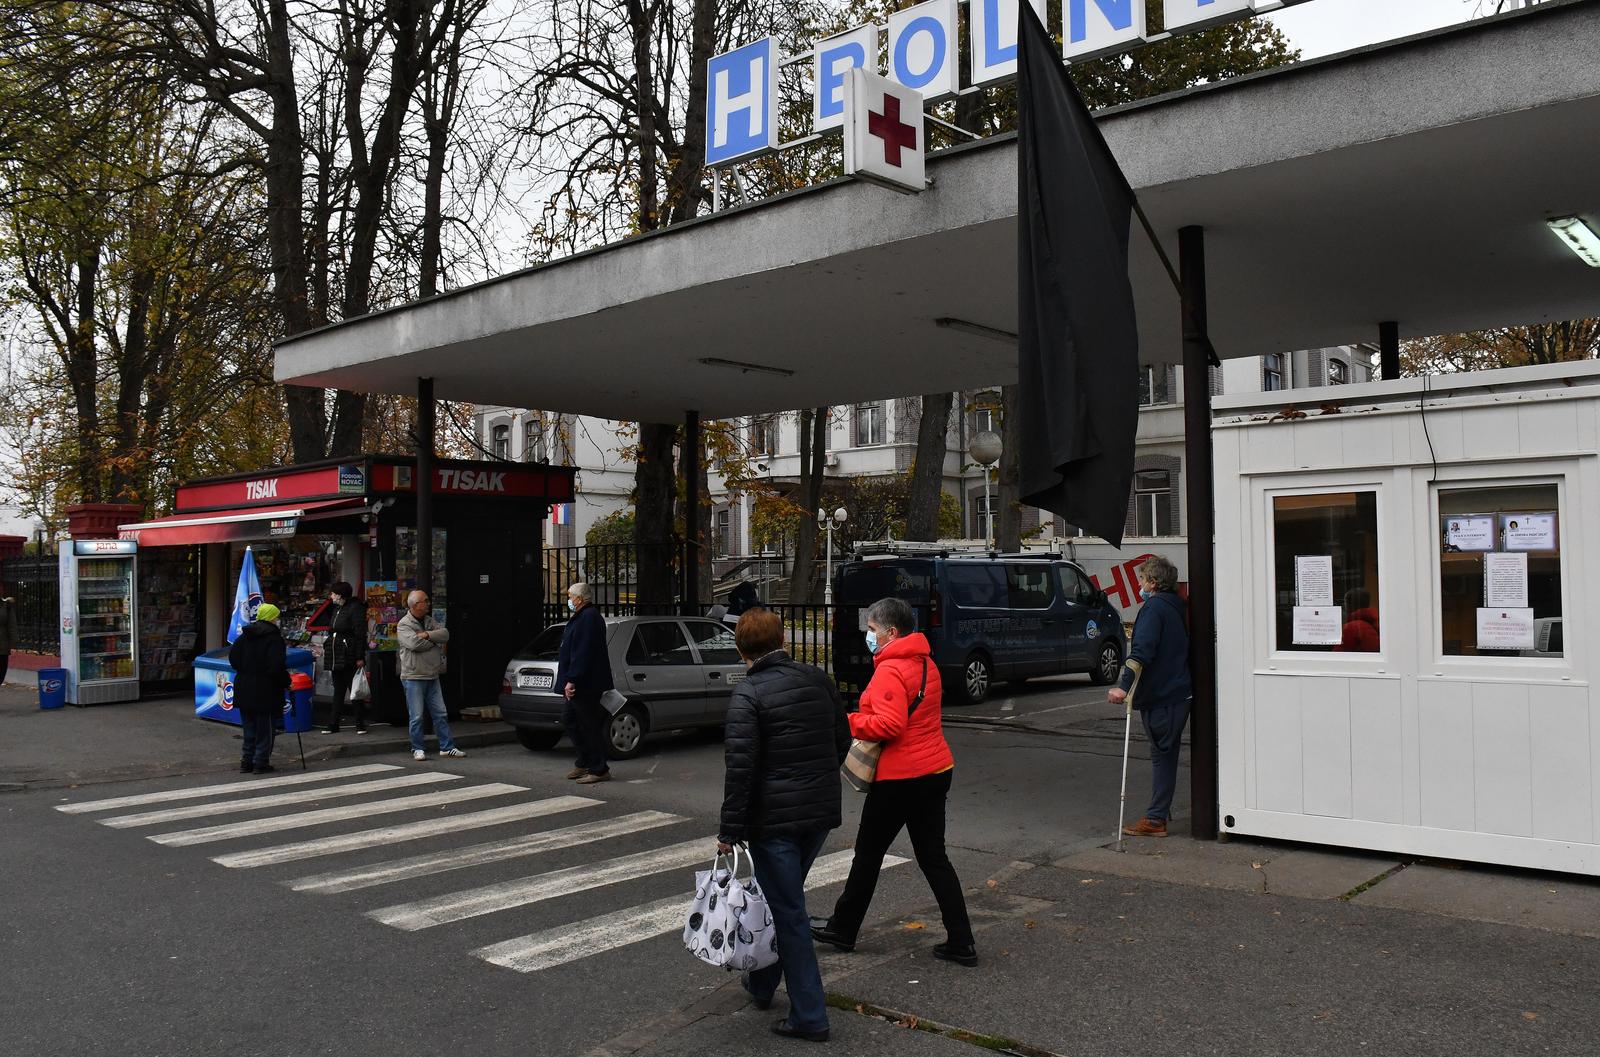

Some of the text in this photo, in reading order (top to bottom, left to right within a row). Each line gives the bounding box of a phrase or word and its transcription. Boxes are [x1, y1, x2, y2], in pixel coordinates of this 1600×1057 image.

[714, 57, 763, 148] H
[246, 479, 278, 500] TISAK
[439, 469, 506, 491] TISAK
